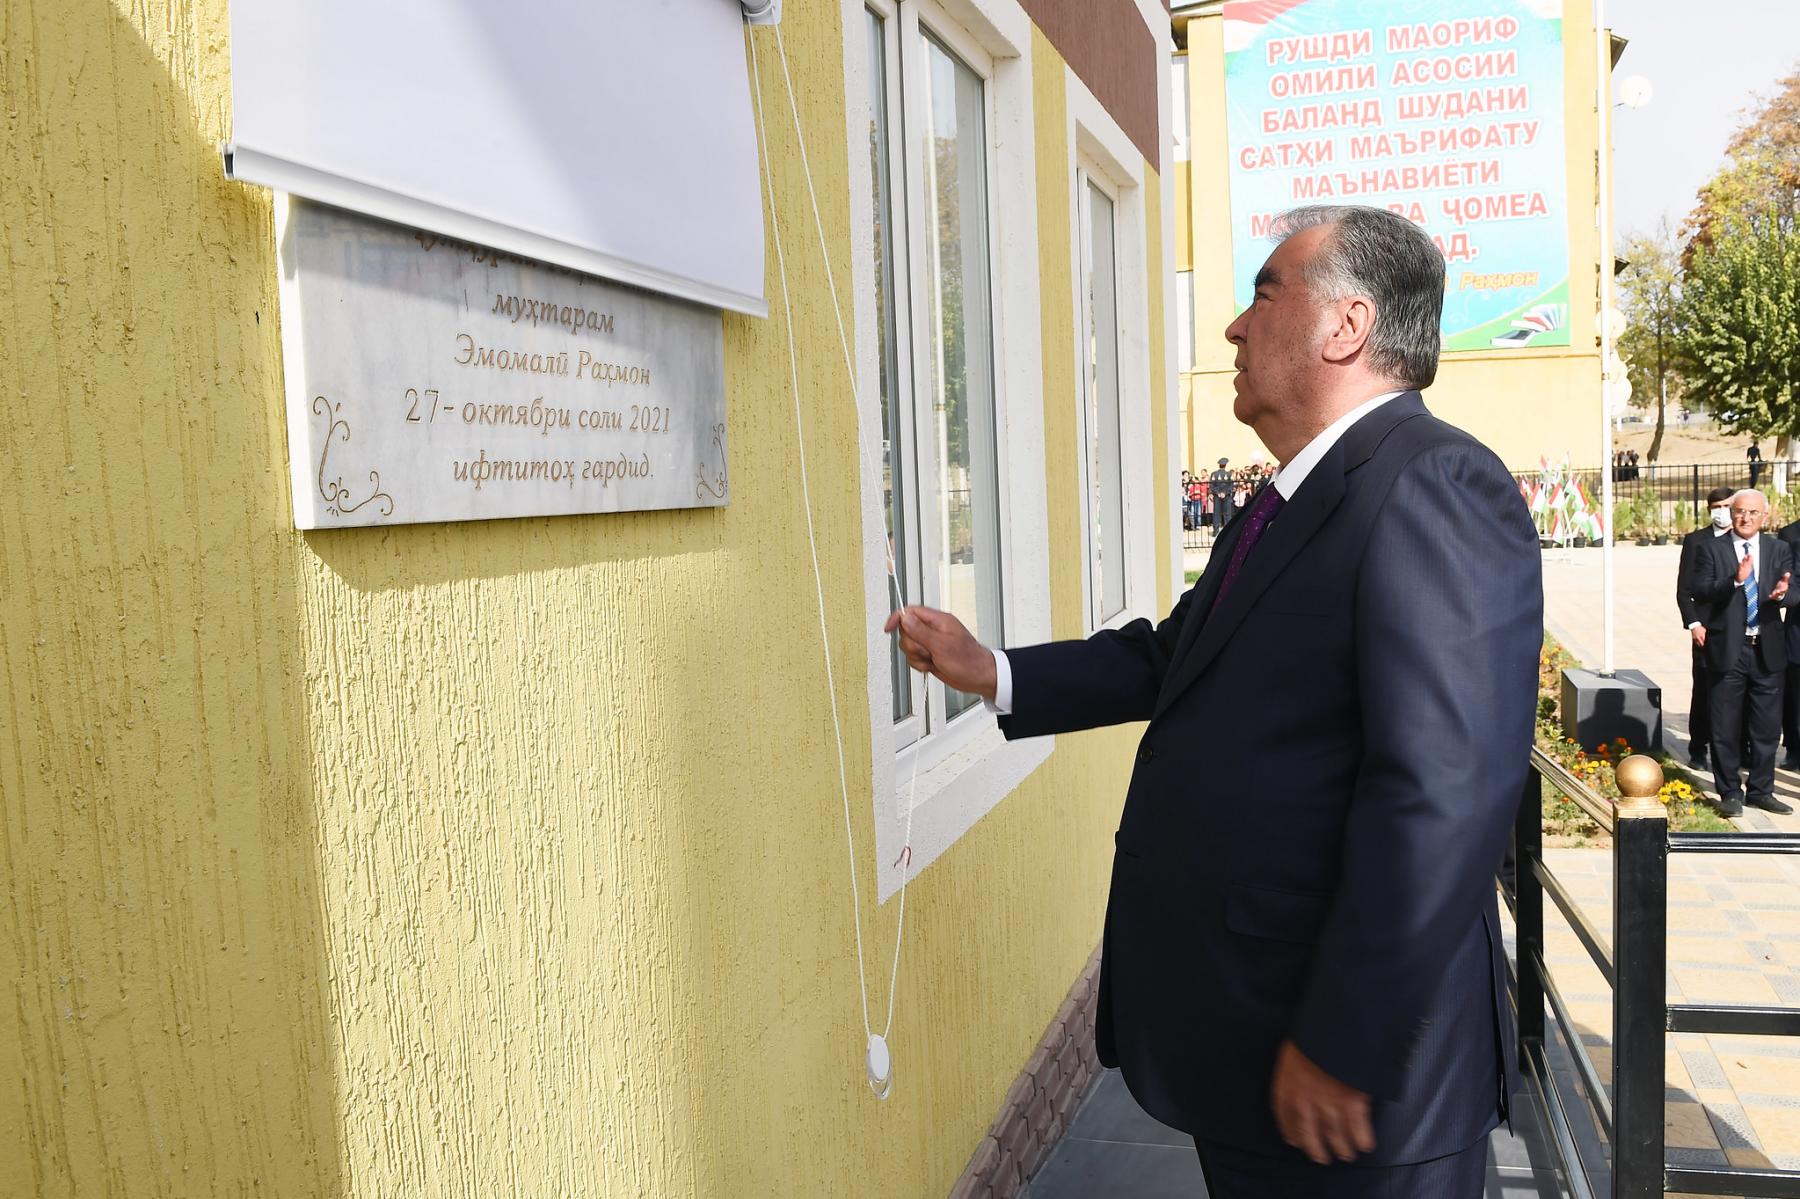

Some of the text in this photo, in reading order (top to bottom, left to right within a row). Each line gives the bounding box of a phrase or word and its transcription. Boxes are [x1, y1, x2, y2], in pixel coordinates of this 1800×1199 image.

[1268, 17, 1518, 64] РУШДИ МАОРИФ
[1271, 52, 1516, 97] ОМИЛИ АСОСИИ
[1263, 87, 1527, 133] БАЛАНД ШУДАНИ
[1240, 121, 1538, 169] САТҲИ МАЪРИФАТУ
[1293, 157, 1500, 199] МАЪНАВИЁТИ
[1442, 192, 1548, 225] ҶОМЕА
[491, 292, 615, 333] муҳтарам
[454, 333, 652, 387] Эмомалӣ Раҳмон
[462, 396, 572, 438] октябри
[578, 406, 622, 431] соли
[629, 404, 671, 434] 2021
[453, 449, 654, 490] ифтитоҳ гардид.
